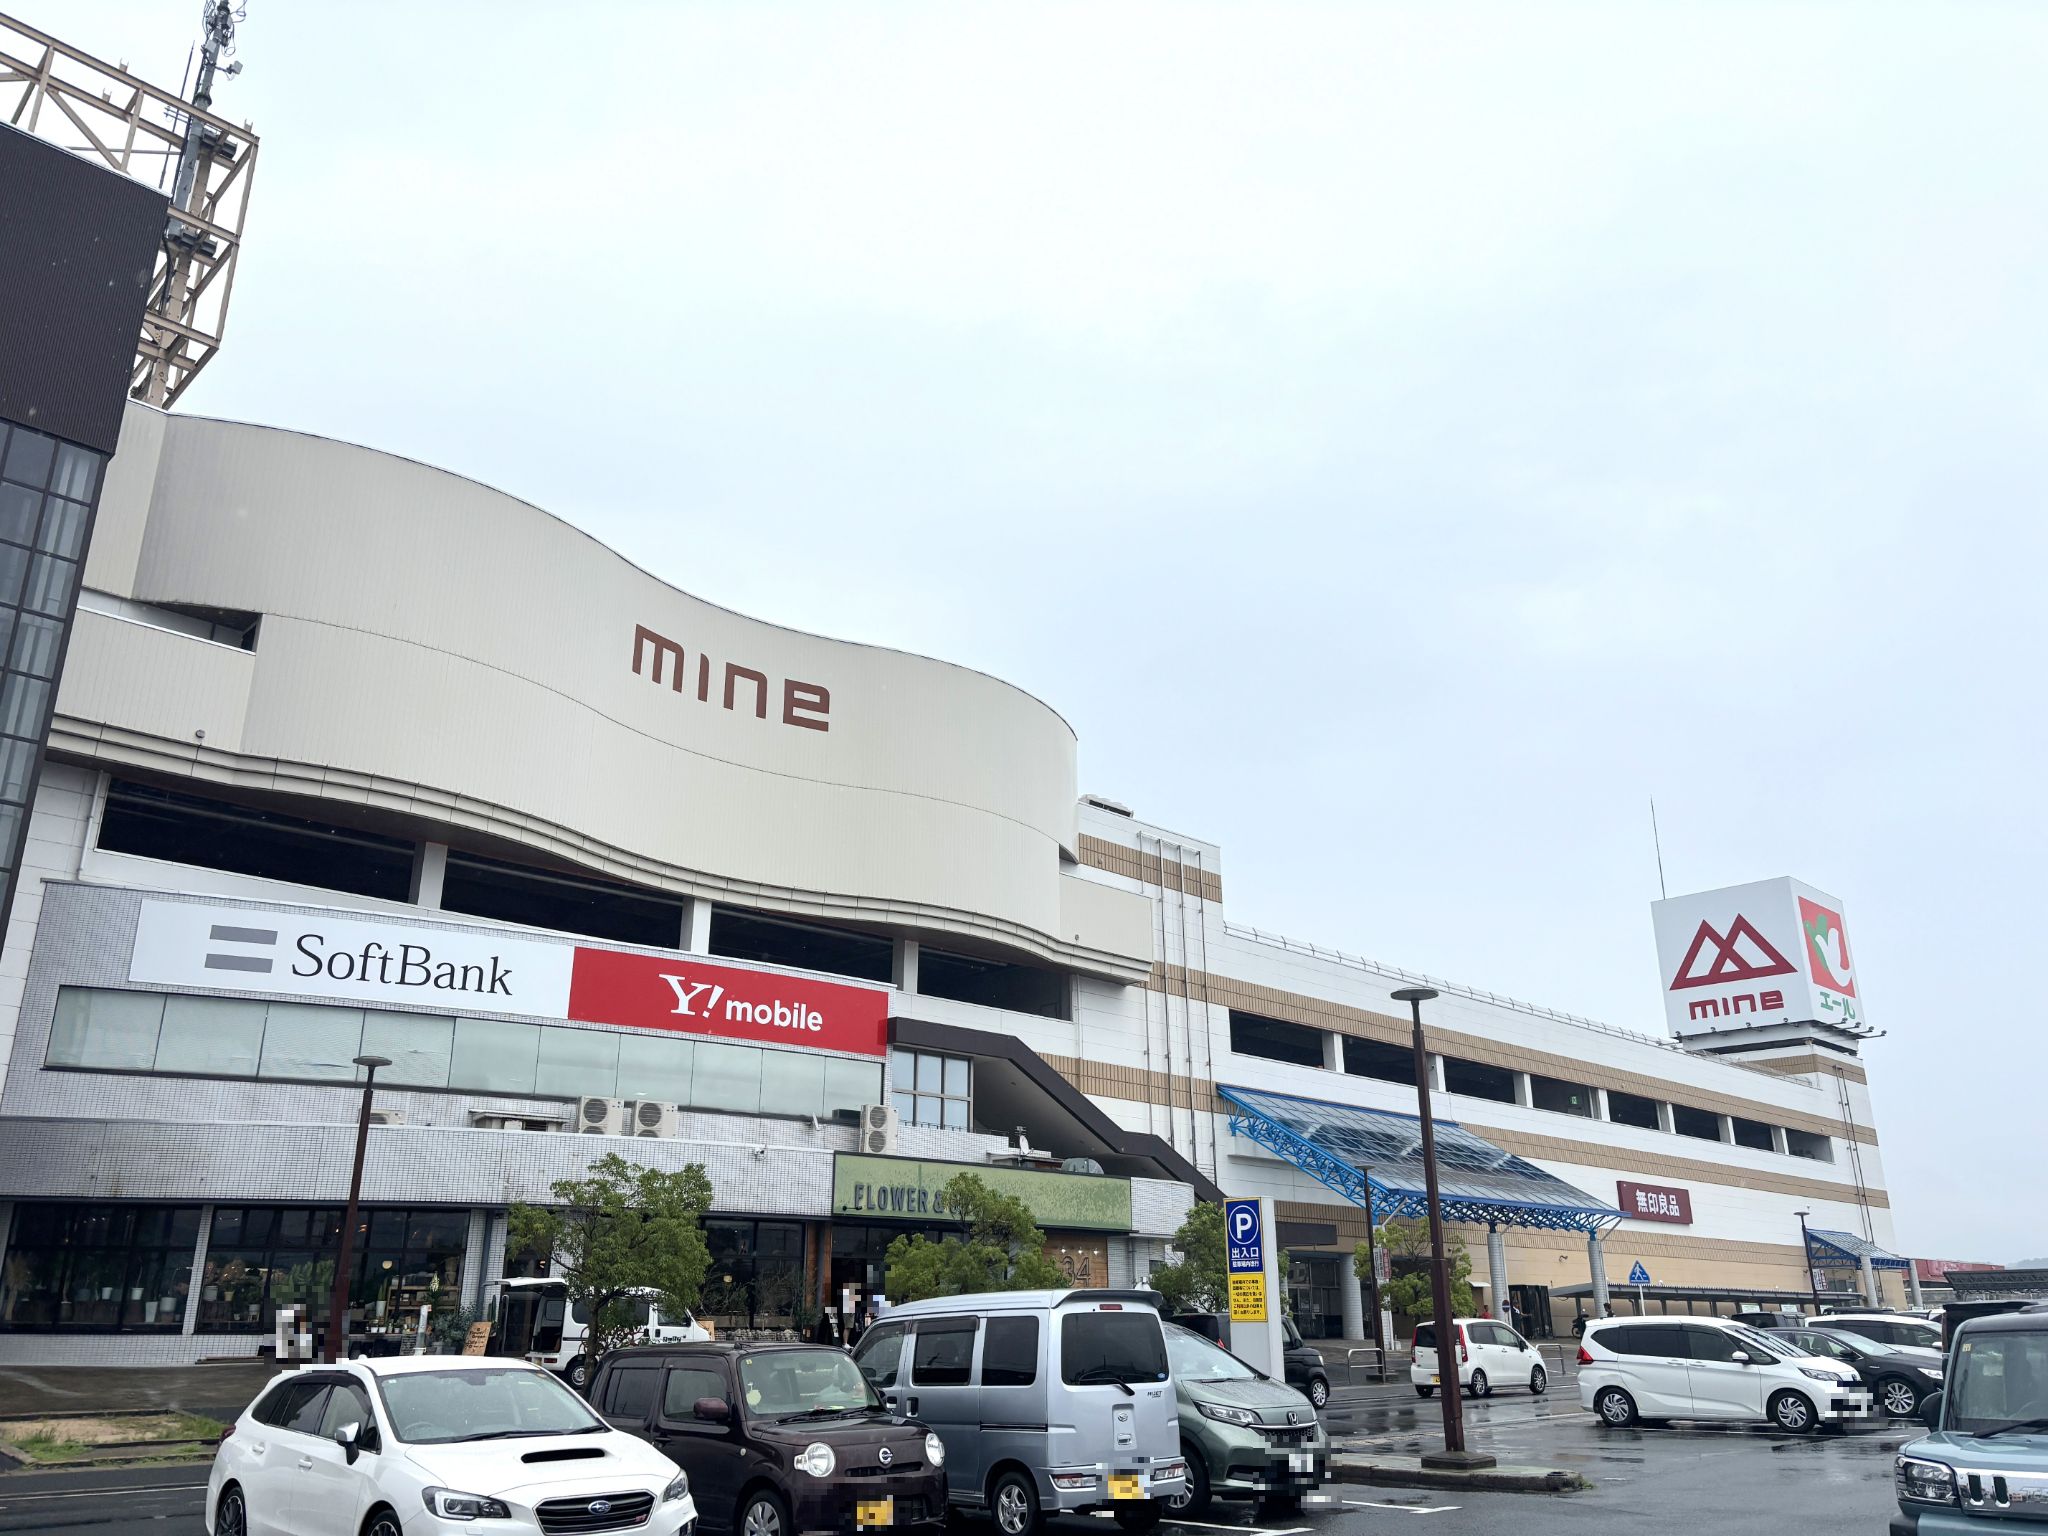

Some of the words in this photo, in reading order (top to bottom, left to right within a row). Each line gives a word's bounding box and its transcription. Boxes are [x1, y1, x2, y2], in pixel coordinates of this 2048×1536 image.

[632, 623, 830, 732] mine
[291, 933, 513, 996] SoftBank
[1689, 990, 1784, 1020] mine
[1819, 991, 1856, 1020] エール
[854, 1183, 929, 1213] FLOWER
[1635, 1188, 1681, 1217] 無印良品
[1235, 1213, 1253, 1240] P
[1231, 1247, 1259, 1258] 出入口
